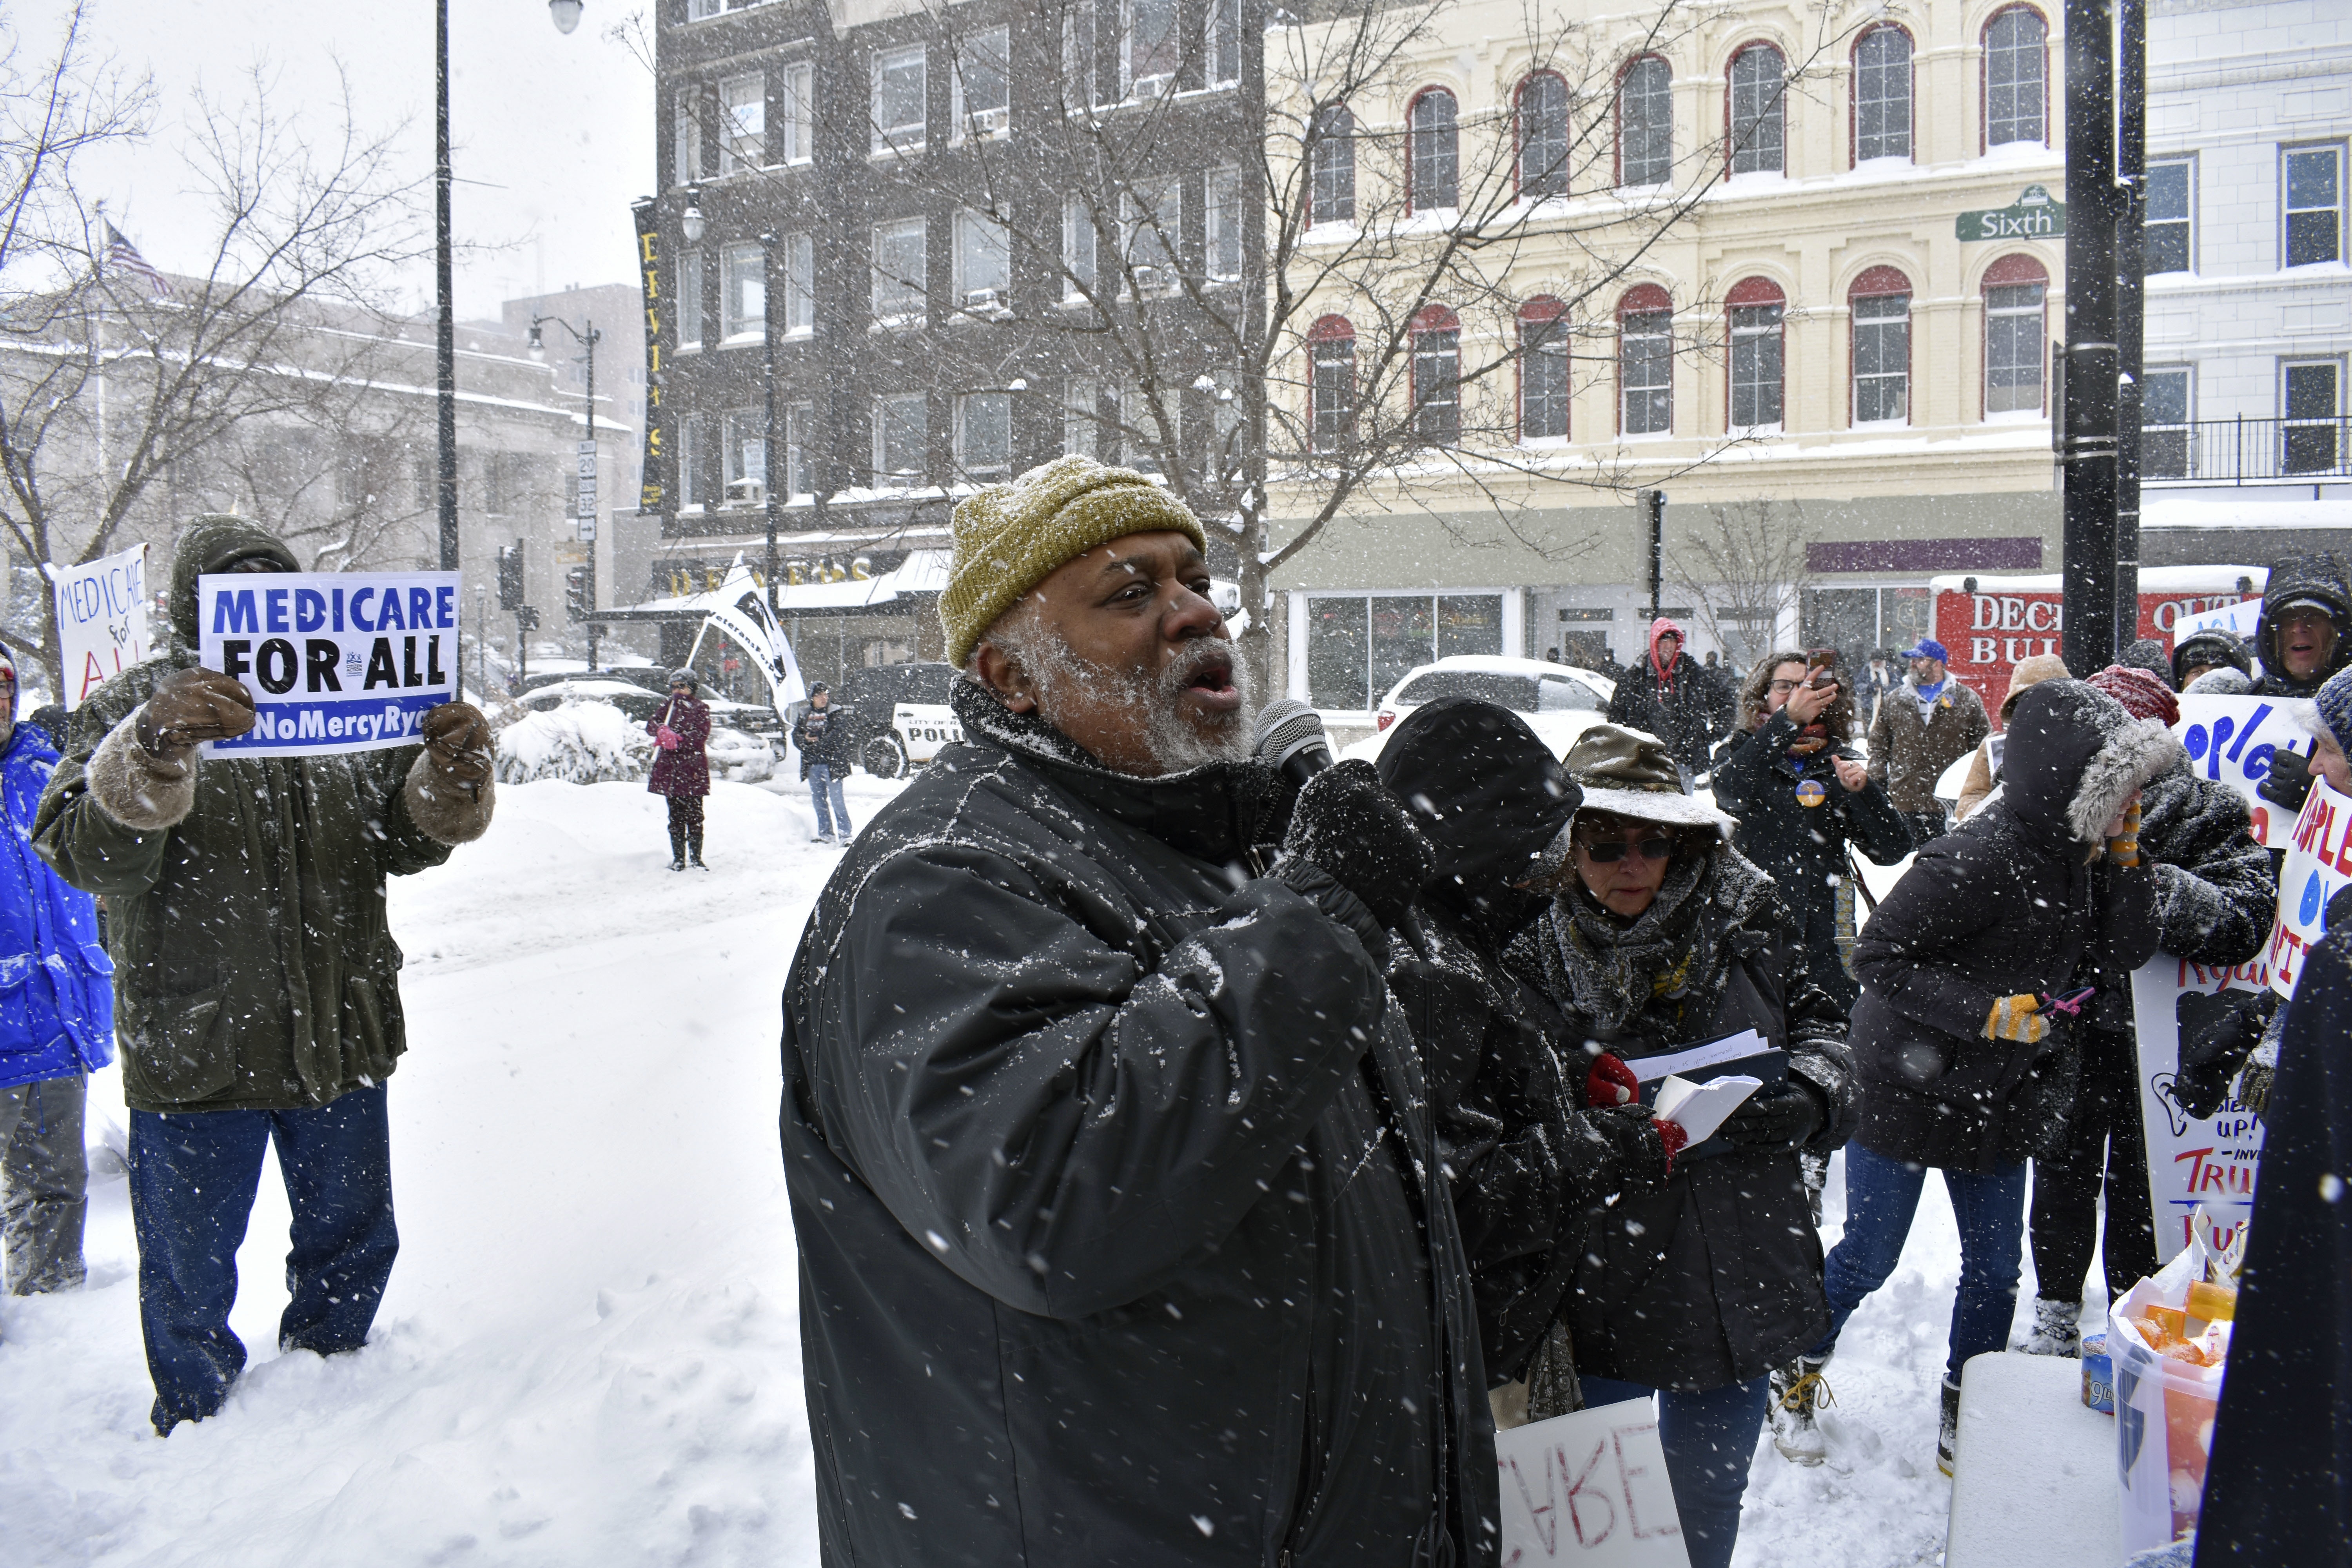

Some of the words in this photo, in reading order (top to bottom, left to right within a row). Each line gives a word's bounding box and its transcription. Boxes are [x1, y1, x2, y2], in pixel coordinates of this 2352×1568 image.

[1981, 210, 2052, 237] Sixth
[580, 458, 595, 472] 20
[580, 497, 593, 511] 32
[212, 586, 454, 633] MEDICARE
[109, 615, 131, 650] for
[223, 637, 343, 695] FOR
[363, 634, 446, 690] ALL
[1302, 743, 1327, 755] SHURE
